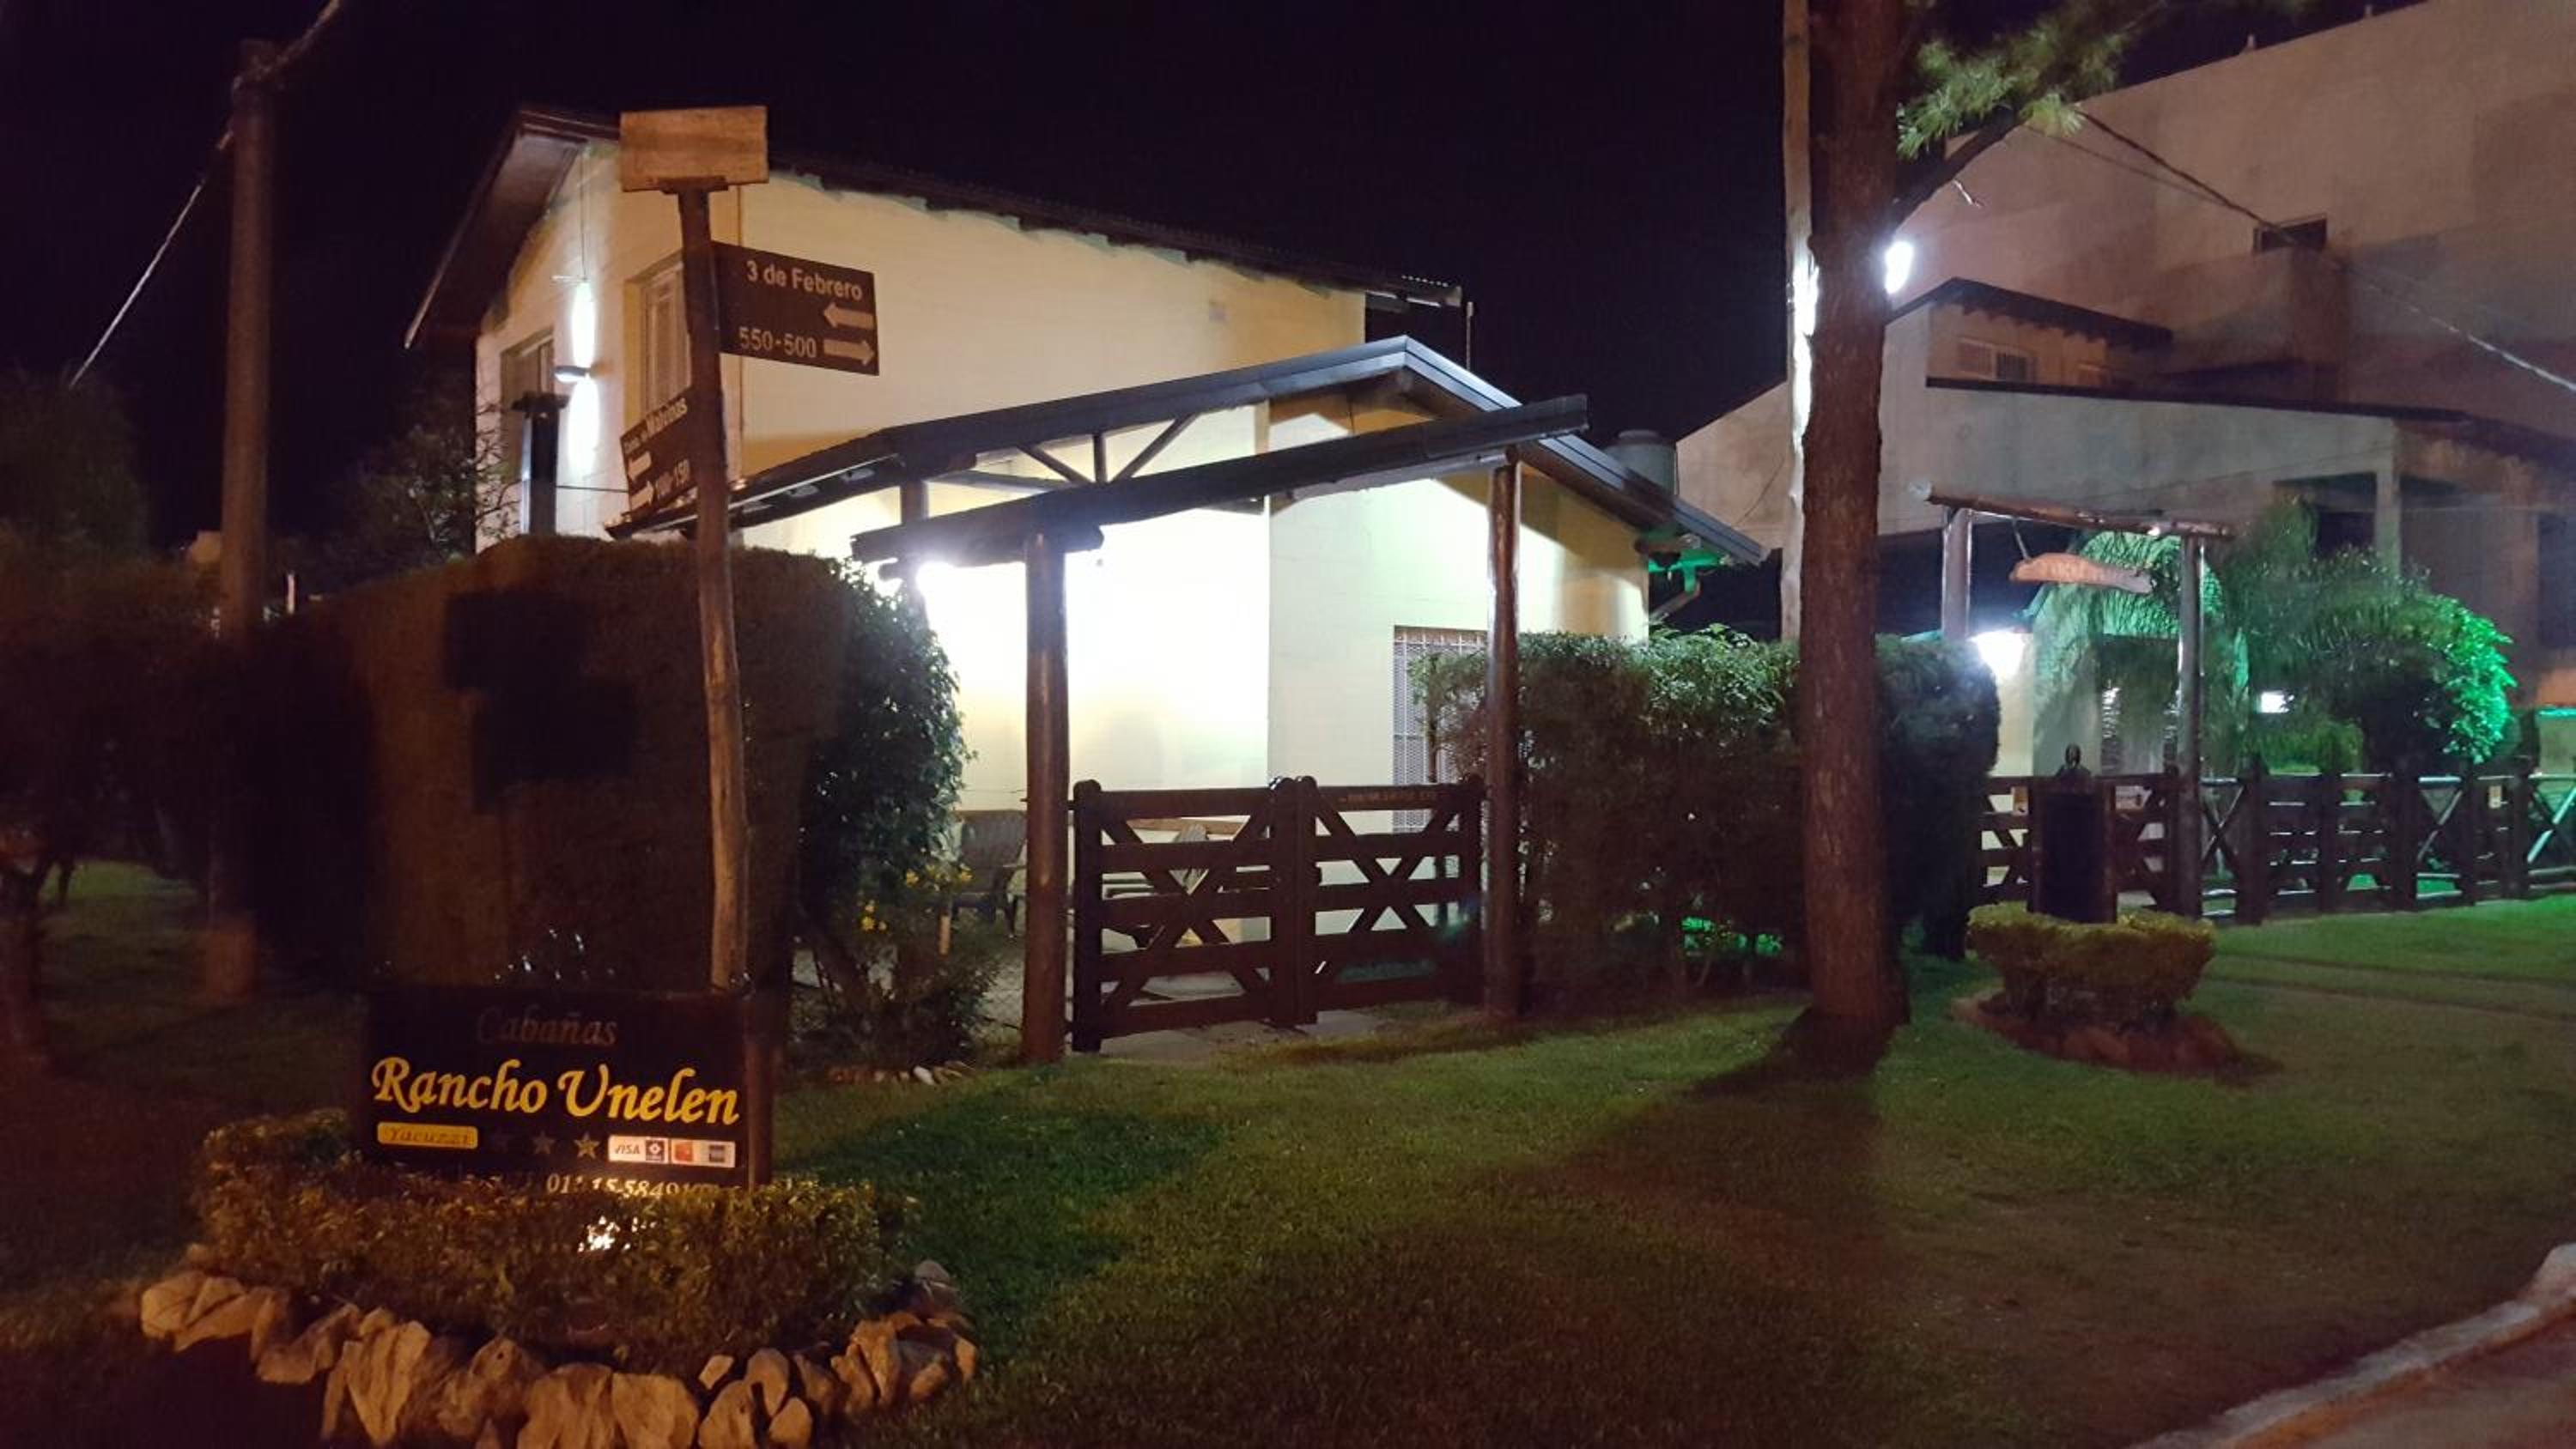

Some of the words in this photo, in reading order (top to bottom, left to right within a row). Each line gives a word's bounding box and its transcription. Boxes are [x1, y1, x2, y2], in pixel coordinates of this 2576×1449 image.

[746, 260, 758, 282] 3
[762, 264, 787, 288] de
[792, 267, 863, 300] Febrero
[738, 325, 817, 358] 550-500
[477, 1003, 618, 1046] Cabañas
[371, 1057, 548, 1113] Rancho
[556, 1064, 740, 1125] Unelen
